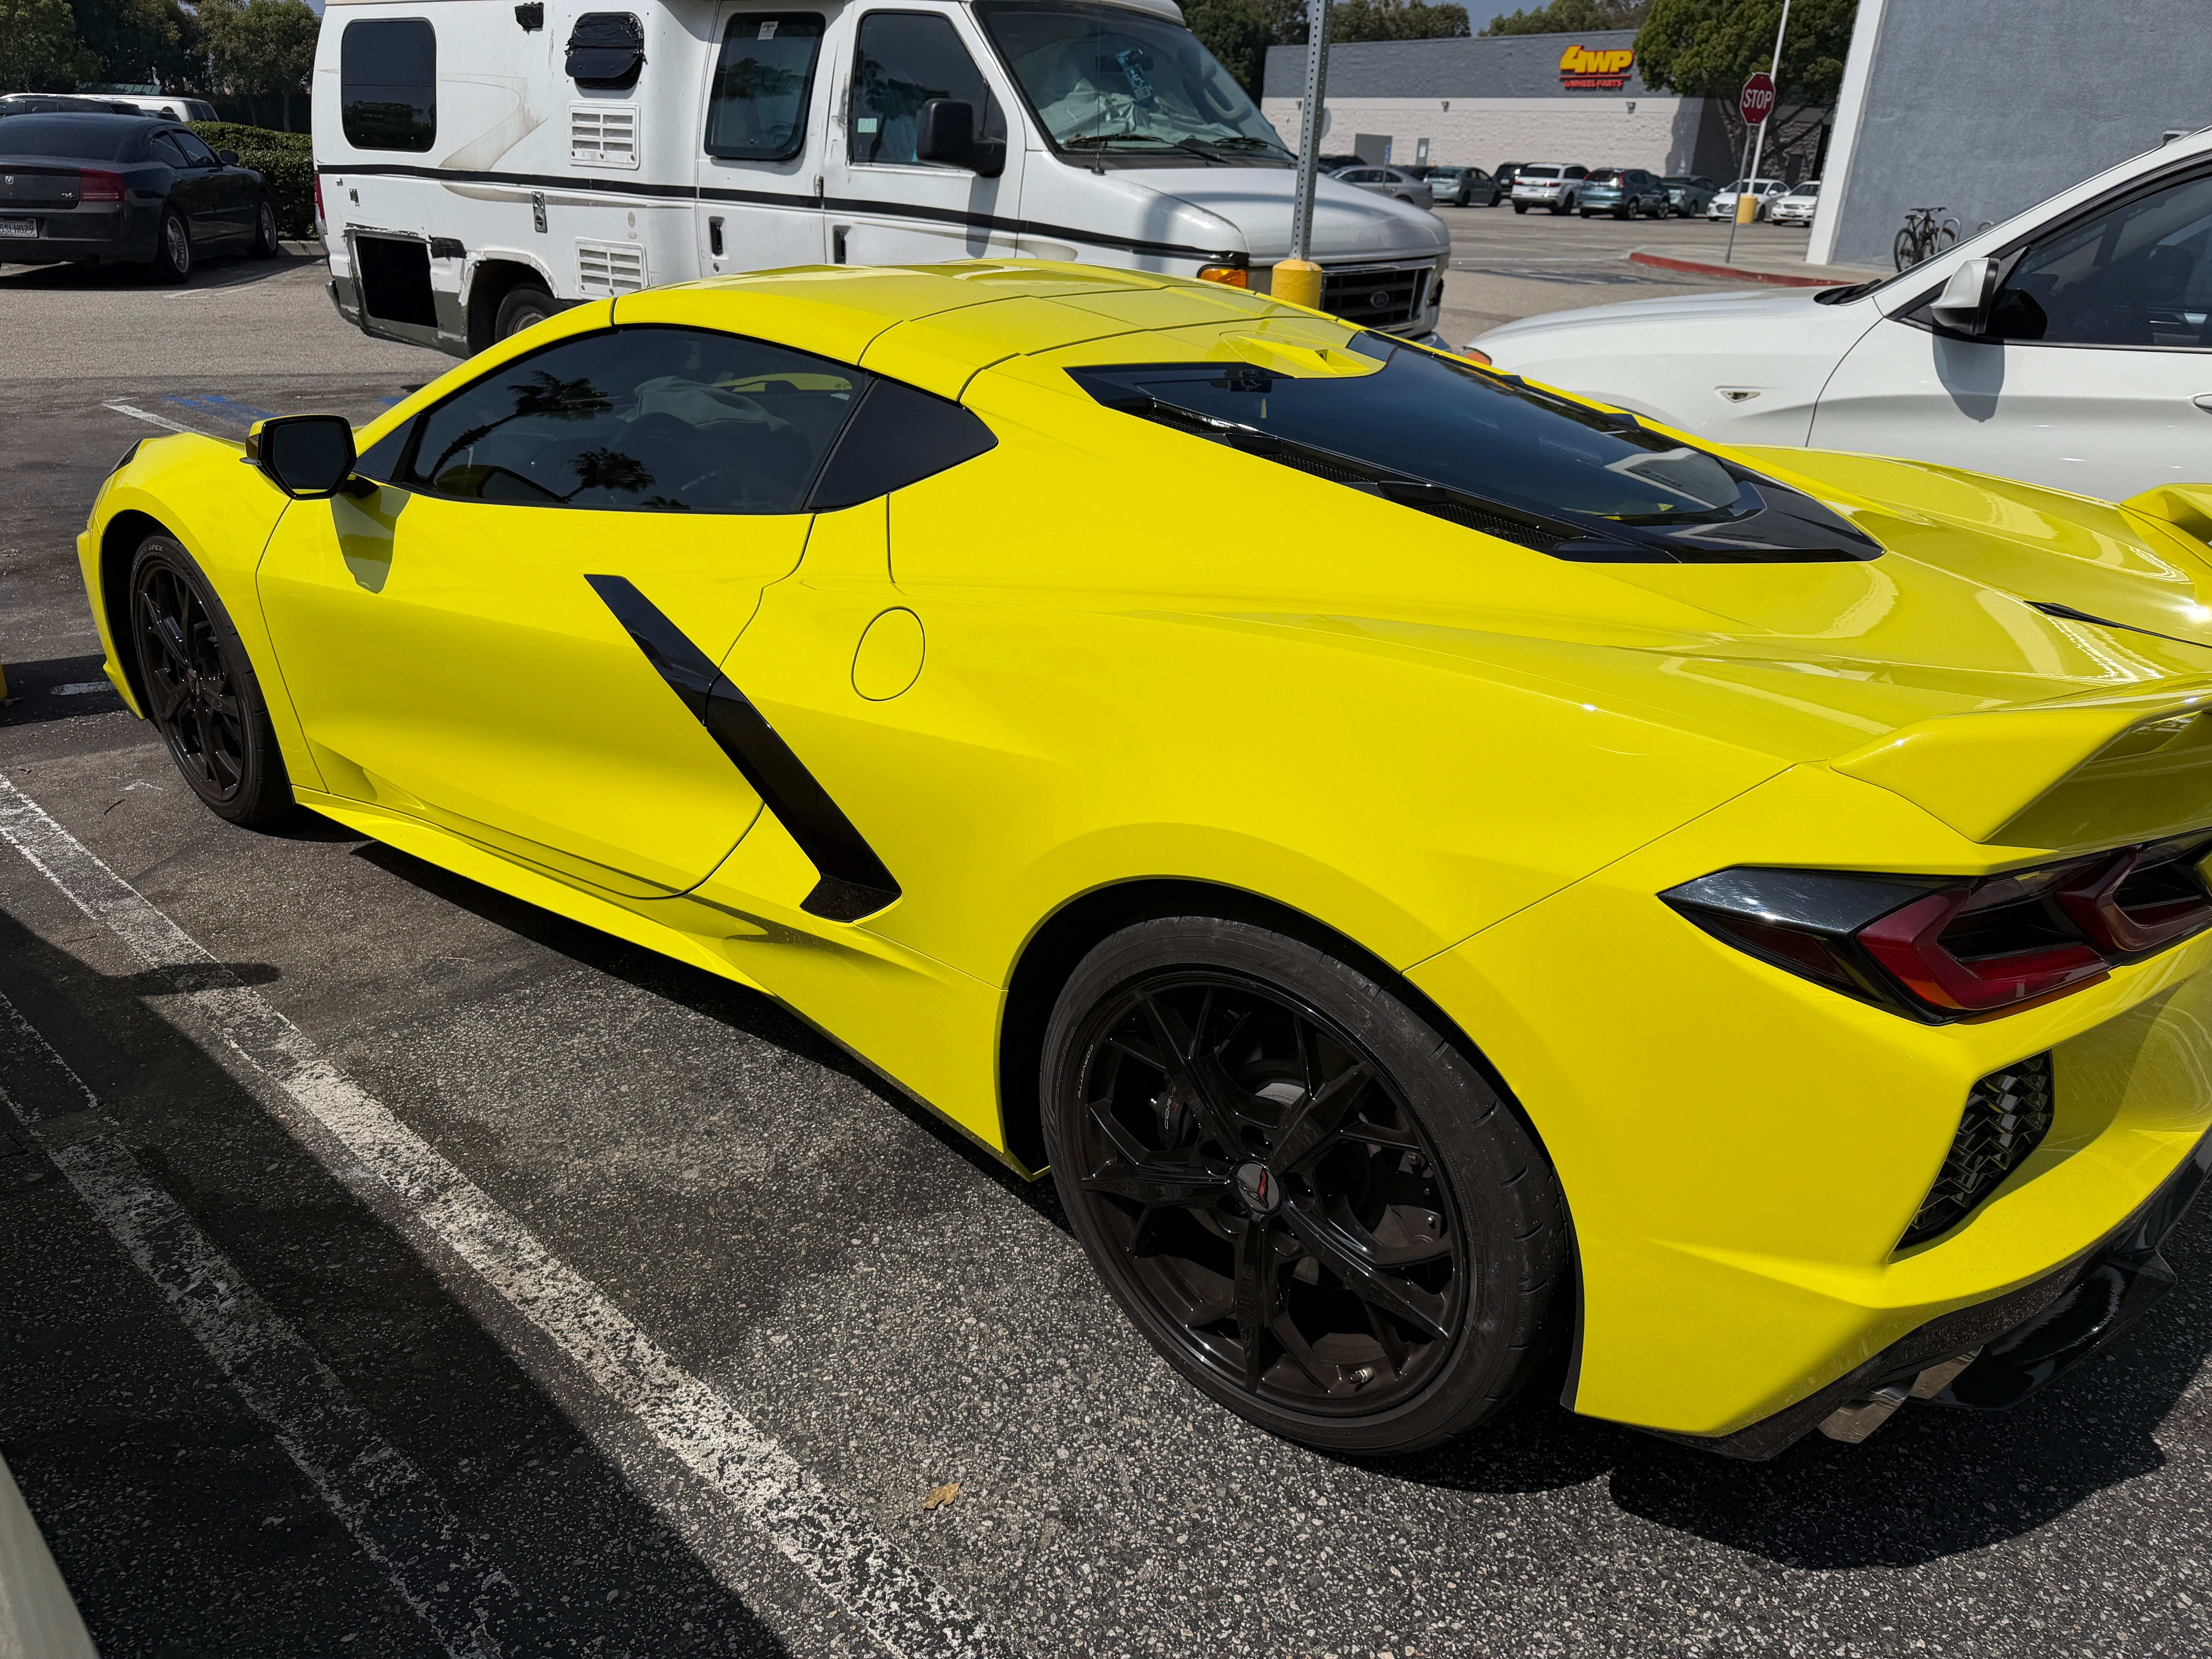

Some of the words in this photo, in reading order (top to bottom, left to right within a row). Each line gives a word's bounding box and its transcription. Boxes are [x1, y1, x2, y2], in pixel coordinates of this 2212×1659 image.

[1559, 45, 1634, 74] 4WP
[1743, 88, 1772, 109] STOP
[1078, 1044, 1094, 1099] CORVETTE
